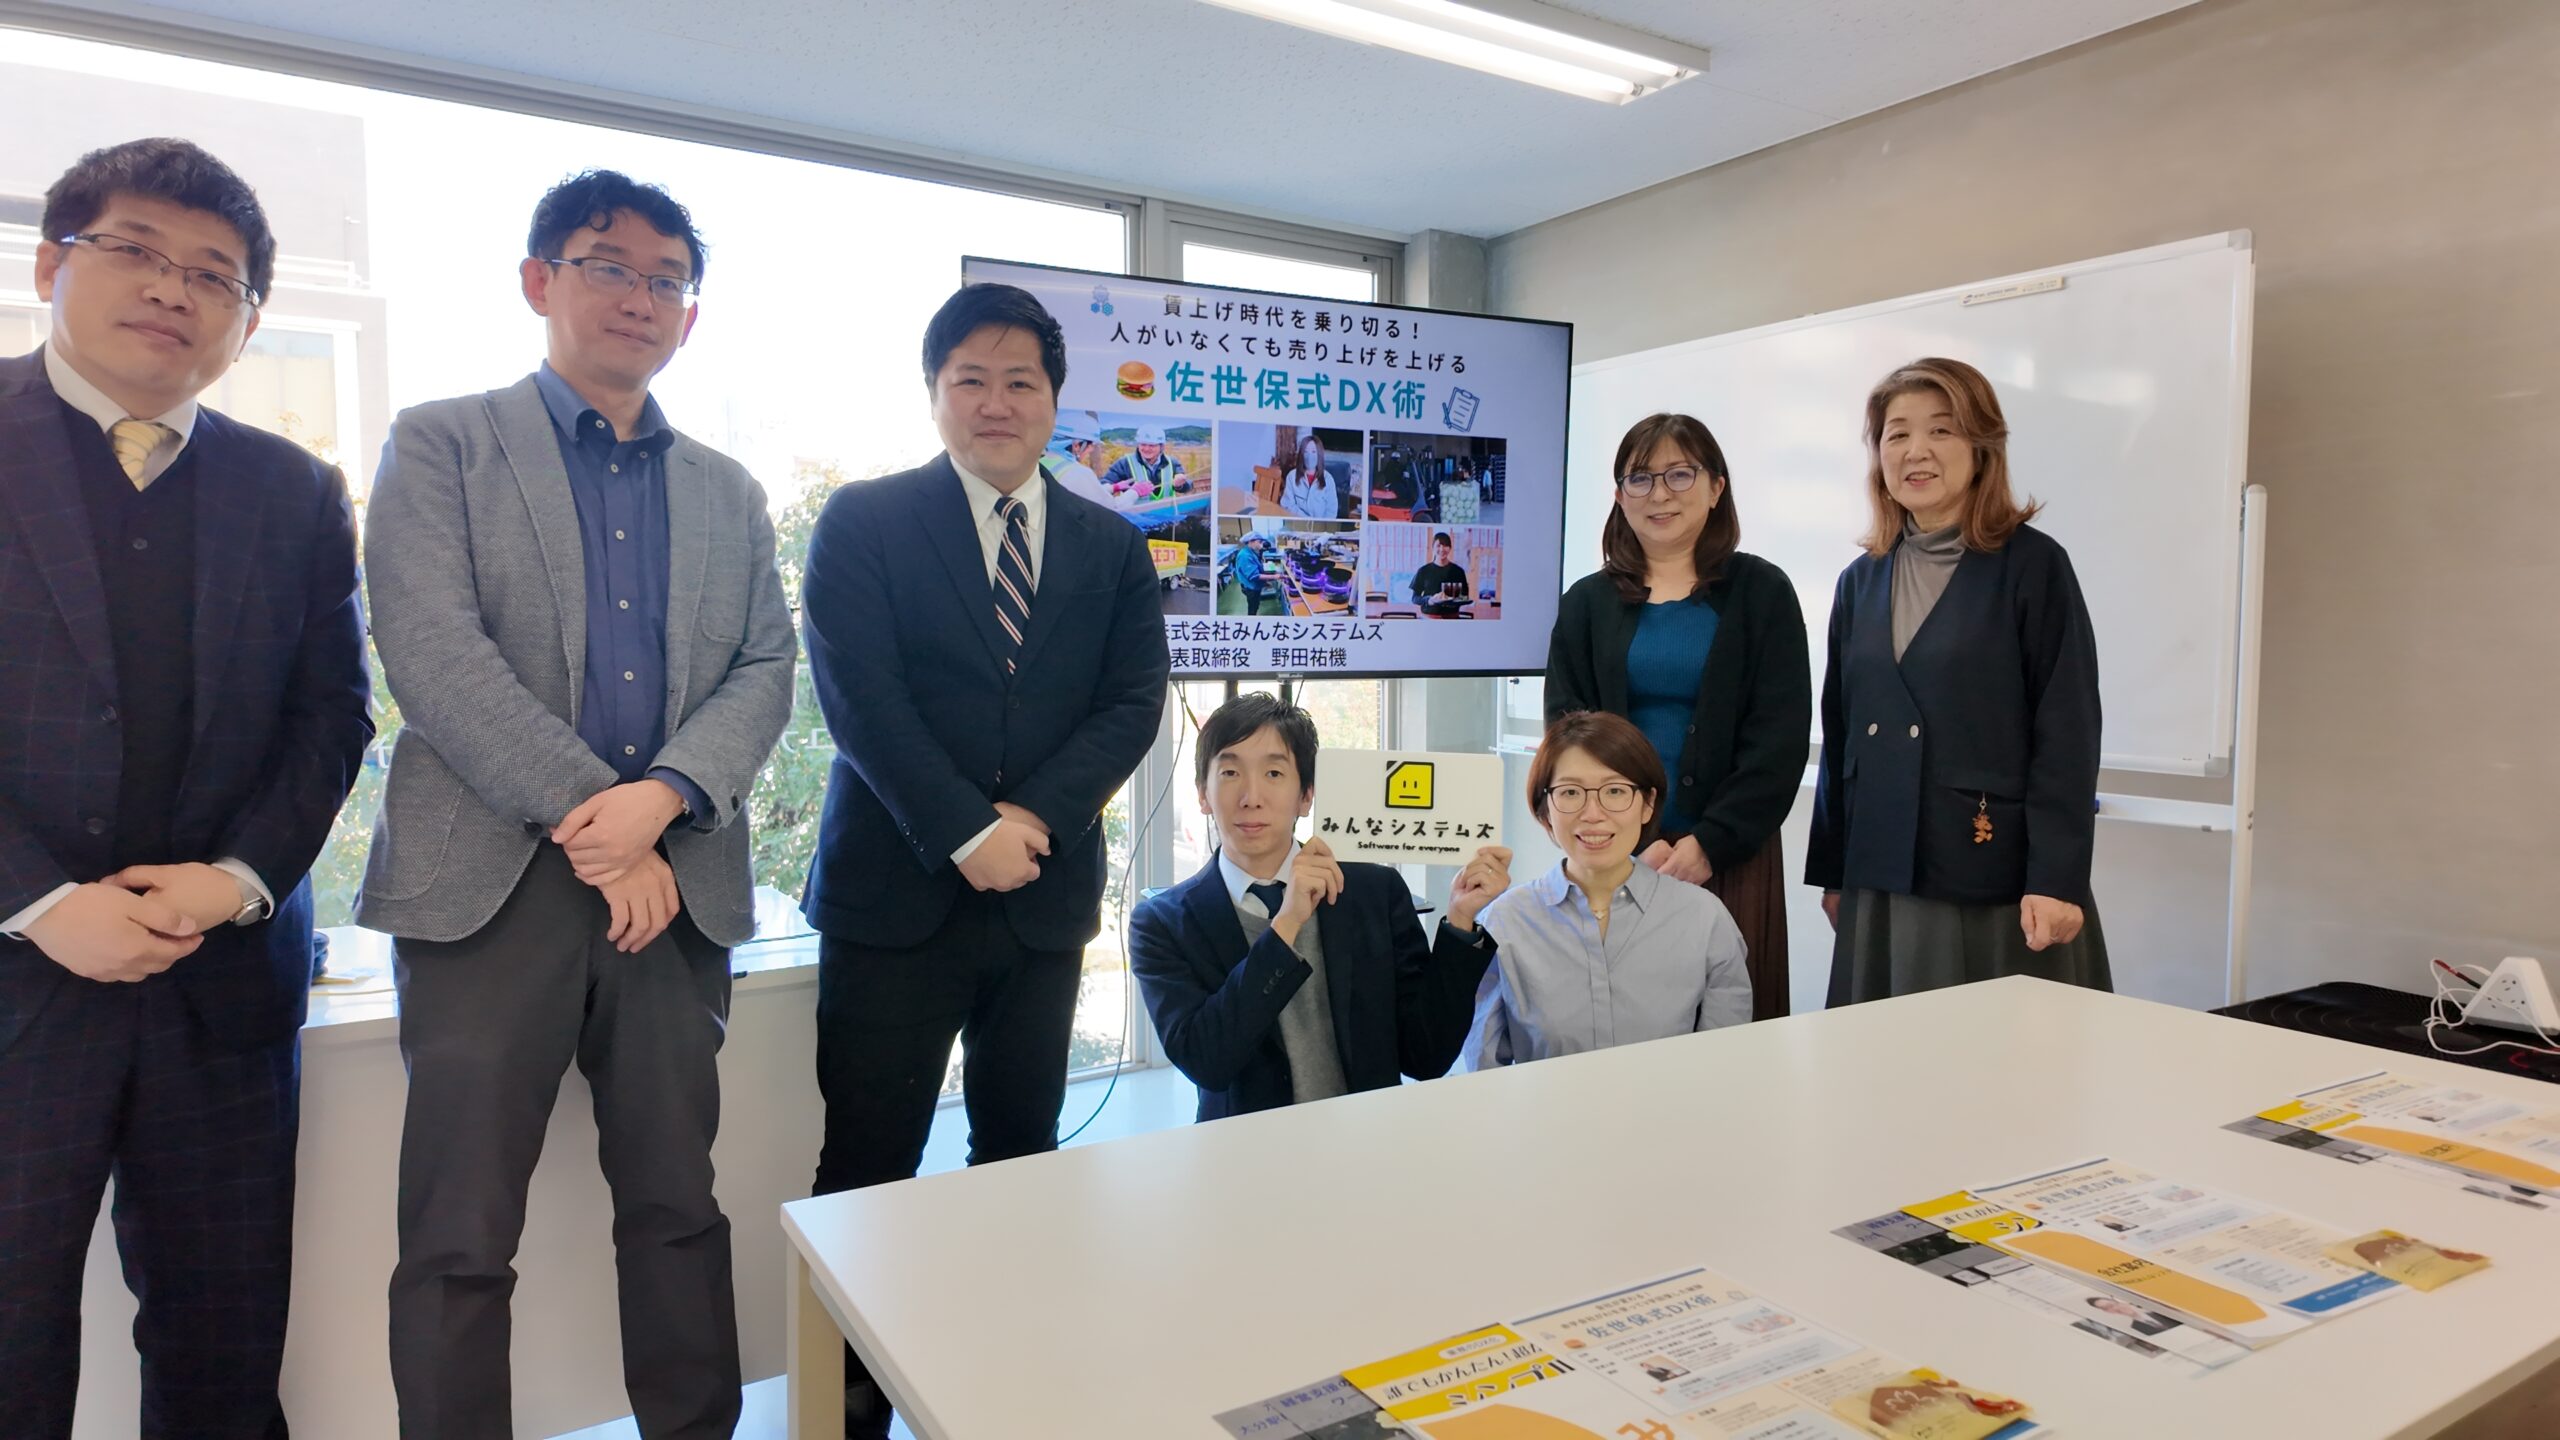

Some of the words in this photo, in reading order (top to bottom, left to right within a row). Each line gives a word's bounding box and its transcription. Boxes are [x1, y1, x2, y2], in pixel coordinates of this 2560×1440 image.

[1163, 294, 1418, 339] 賃上げ時代を乗り切る！
[1110, 322, 1466, 374] 人がいなくても売り上げを上げる
[1166, 360, 1426, 420] 佐世保式DX術
[1164, 620, 1385, 642] 式会社みんなシステムズ
[1321, 816, 1495, 839] みんなシステムズ
[1358, 841, 1399, 851] Software
[1402, 842, 1415, 852] for
[1418, 844, 1461, 854] everyone
[1586, 1293, 1717, 1339] 佐世保式DX術
